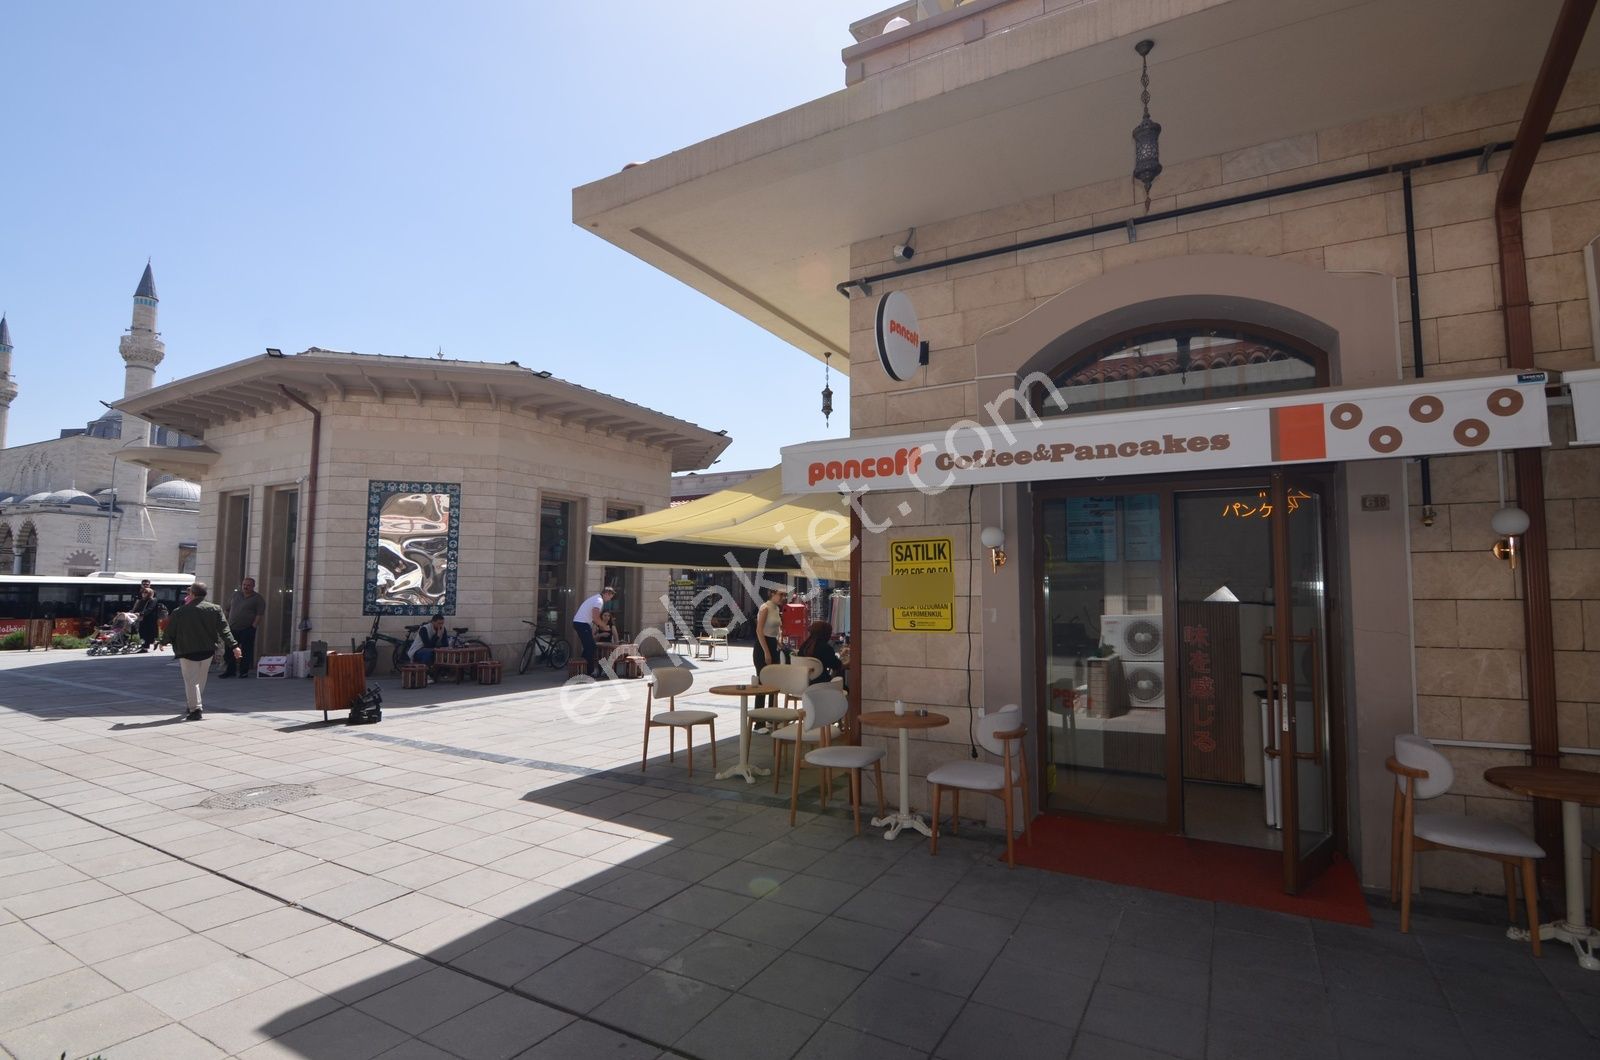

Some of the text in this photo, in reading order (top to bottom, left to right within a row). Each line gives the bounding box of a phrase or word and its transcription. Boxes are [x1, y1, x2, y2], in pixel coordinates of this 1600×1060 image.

[889, 319, 919, 347] pancoff
[807, 433, 1231, 486] pancoff Coffee&Pancakes
[895, 543, 947, 562] SATILIK
